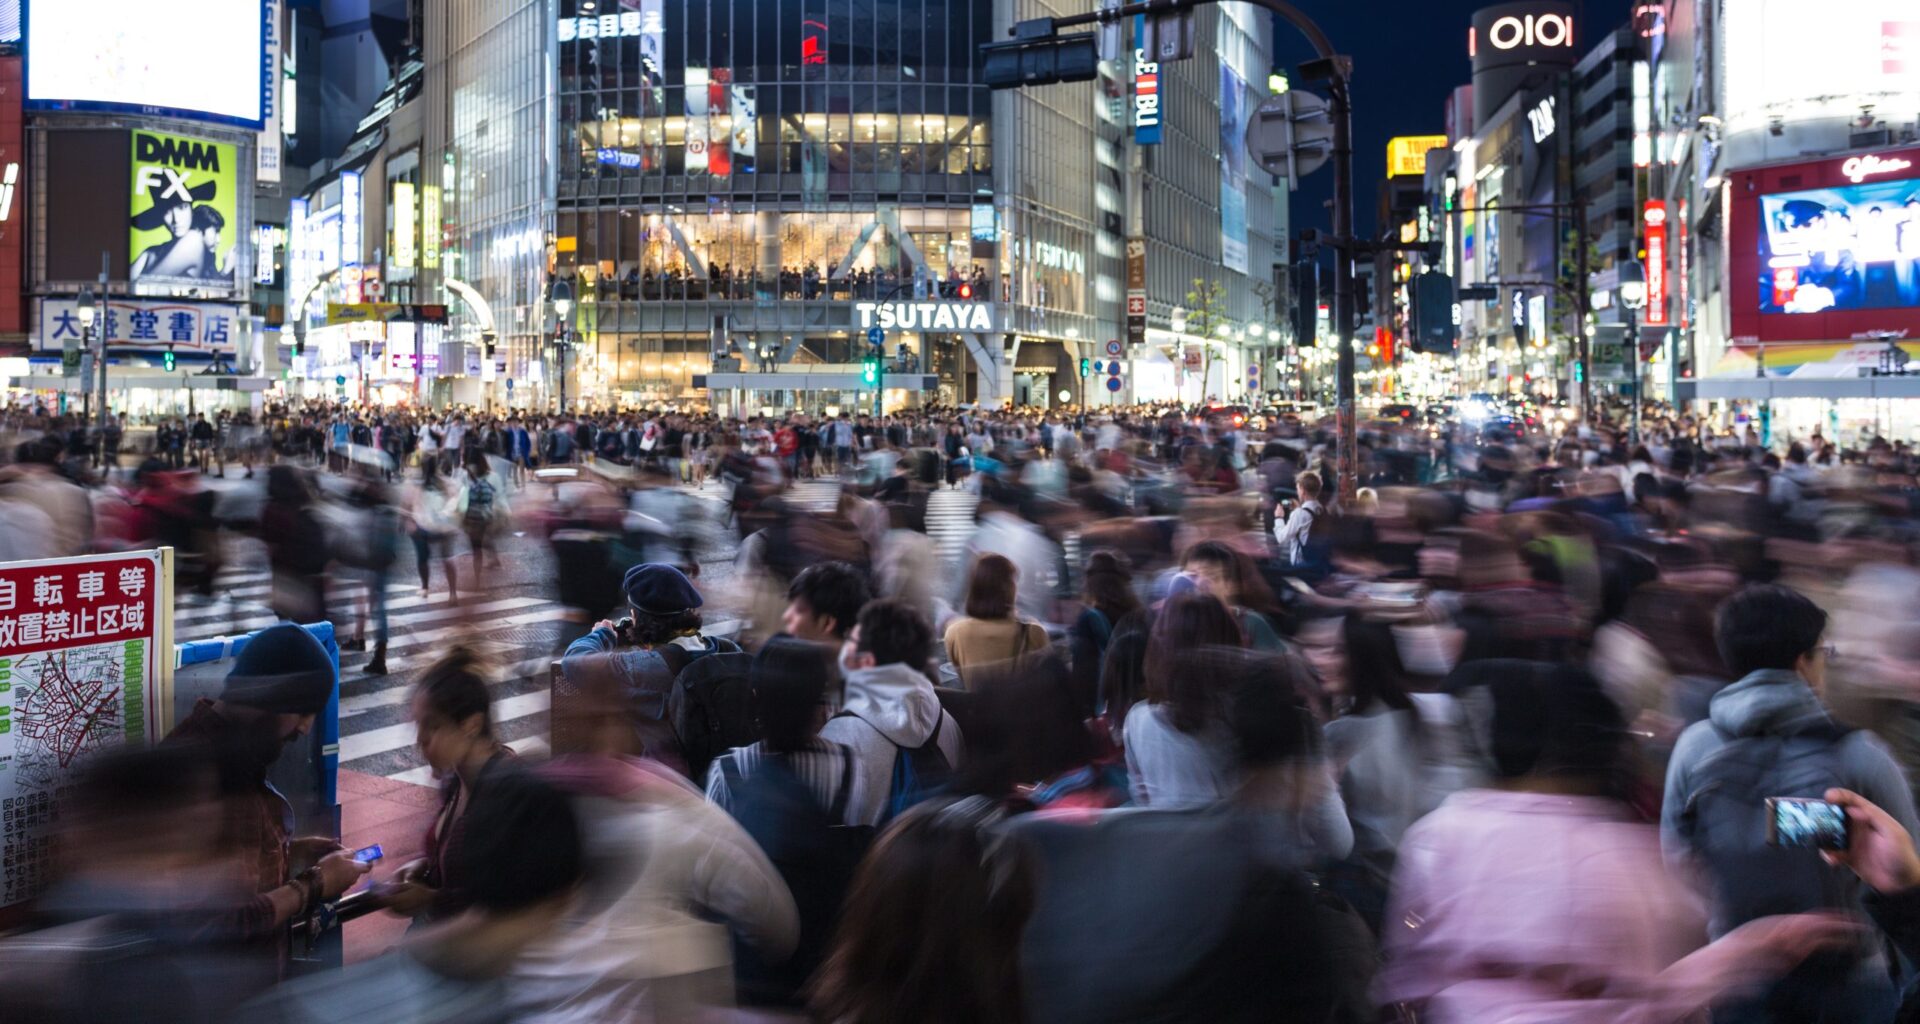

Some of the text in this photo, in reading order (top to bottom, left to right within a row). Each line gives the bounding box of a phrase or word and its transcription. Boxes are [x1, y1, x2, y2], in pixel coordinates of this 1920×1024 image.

[136, 134, 219, 173] DMM
[135, 167, 193, 202] FX
[856, 303, 991, 329] TSUTAYA
[0, 566, 146, 611] 自転車等
[0, 601, 145, 648] 放置禁止区域
